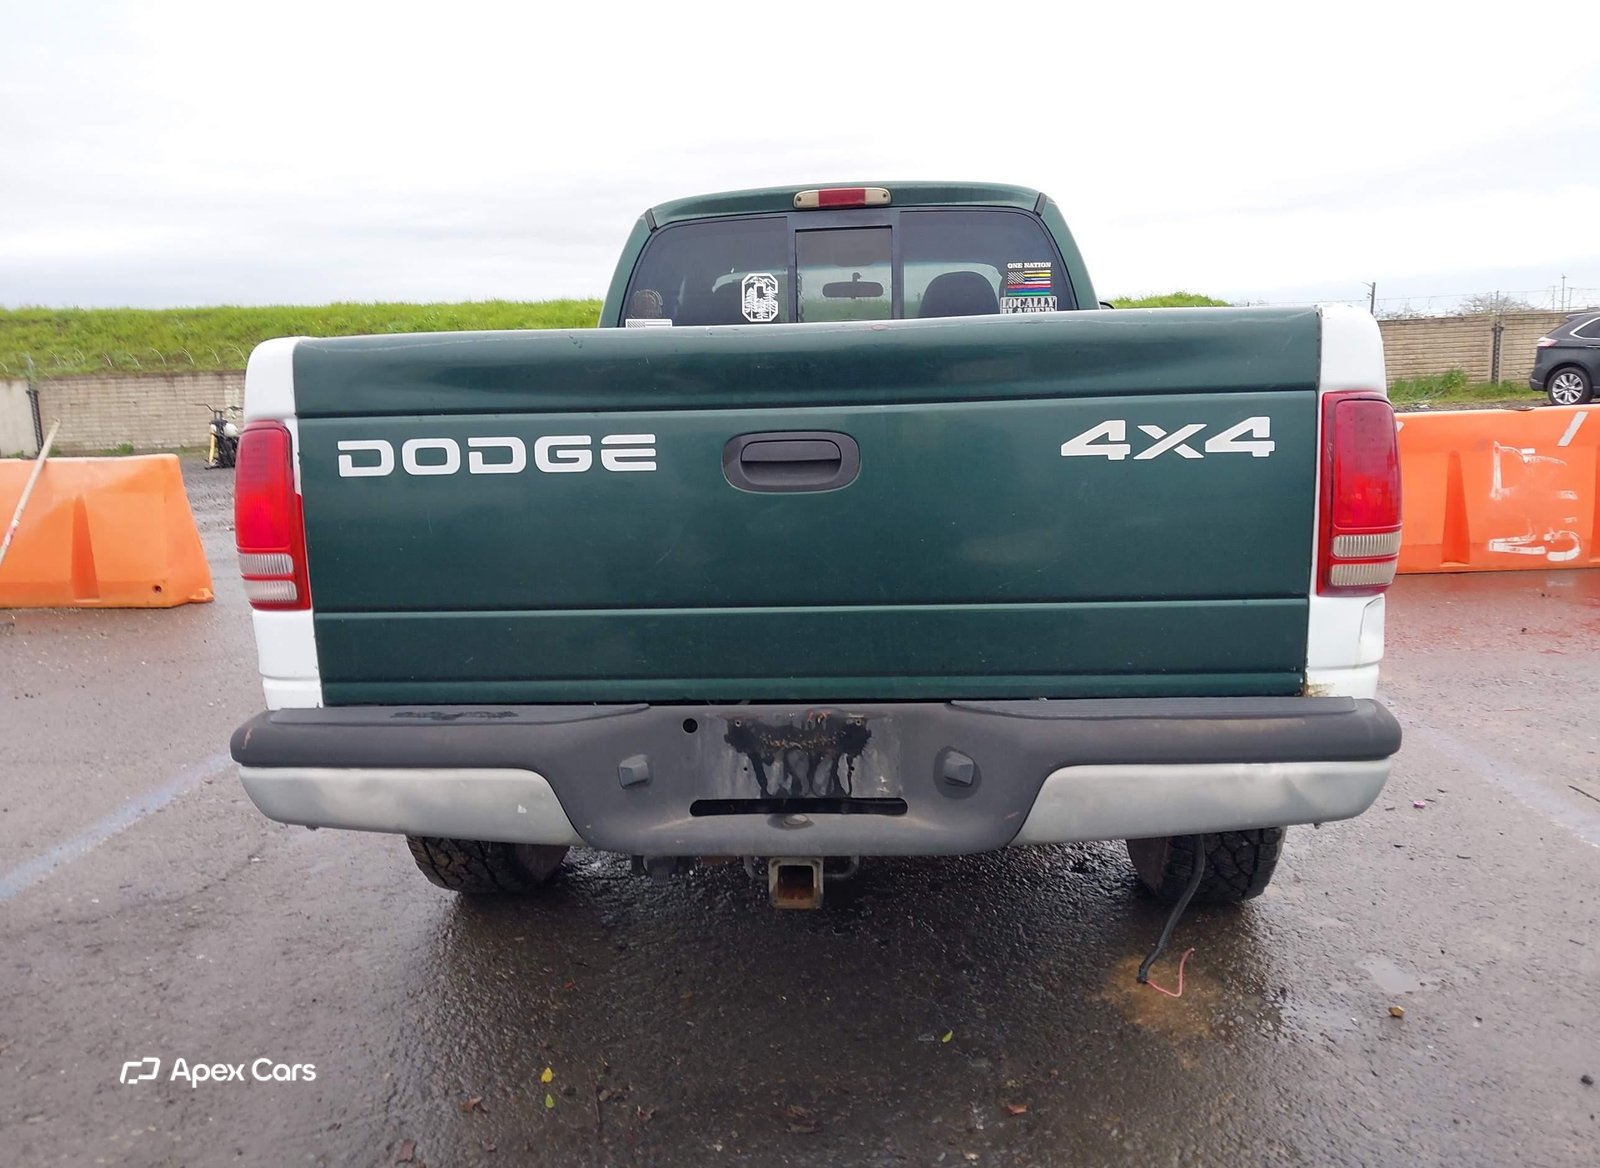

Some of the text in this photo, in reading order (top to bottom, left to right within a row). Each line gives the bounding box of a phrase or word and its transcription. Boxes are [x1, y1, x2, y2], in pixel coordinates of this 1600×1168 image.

[1023, 261, 1052, 269] NATION
[1002, 297, 1055, 308] LOCALLY
[337, 434, 657, 478] DODGE
